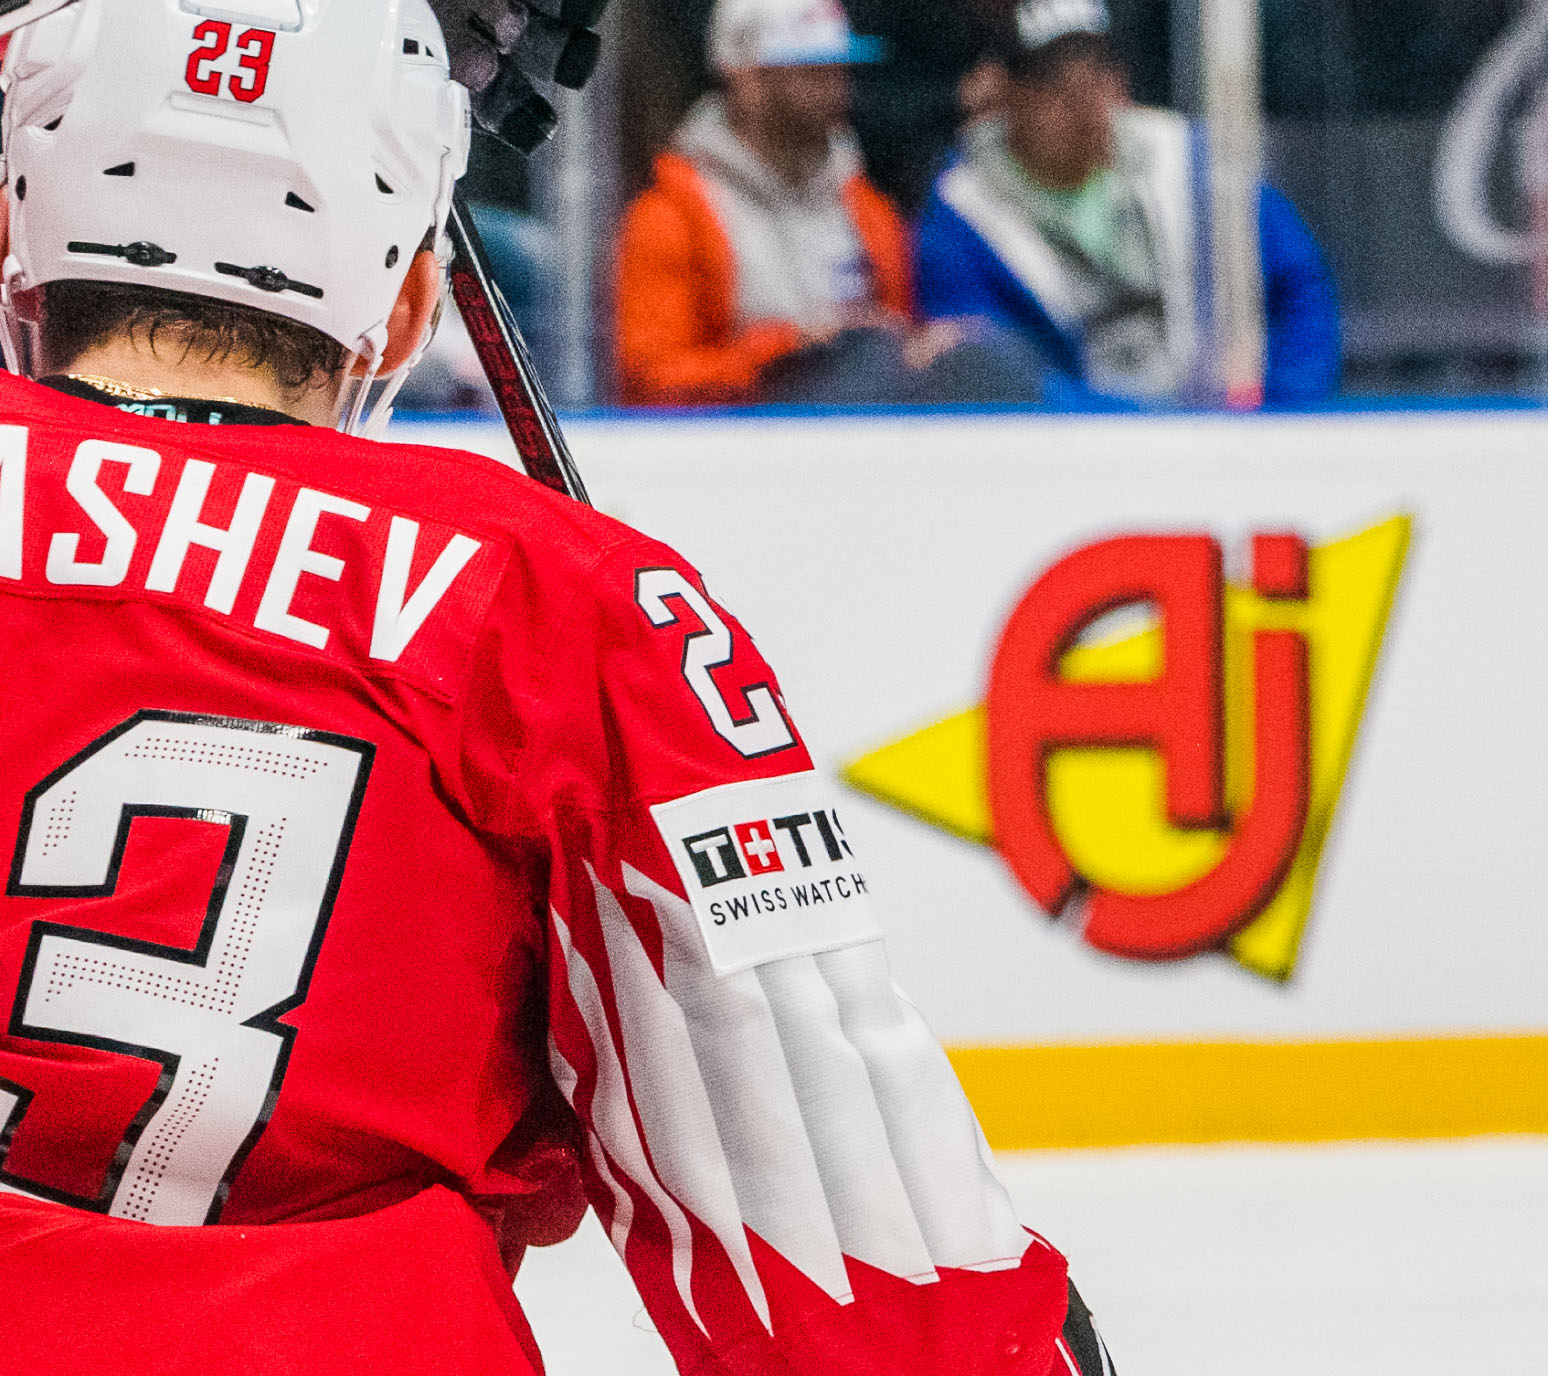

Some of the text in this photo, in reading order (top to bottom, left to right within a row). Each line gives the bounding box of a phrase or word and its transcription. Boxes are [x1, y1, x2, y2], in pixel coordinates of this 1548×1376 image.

[185, 20, 275, 102] 23
[634, 565, 799, 758] 2
[772, 808, 855, 868] TI
[710, 887, 788, 926] SWISS
